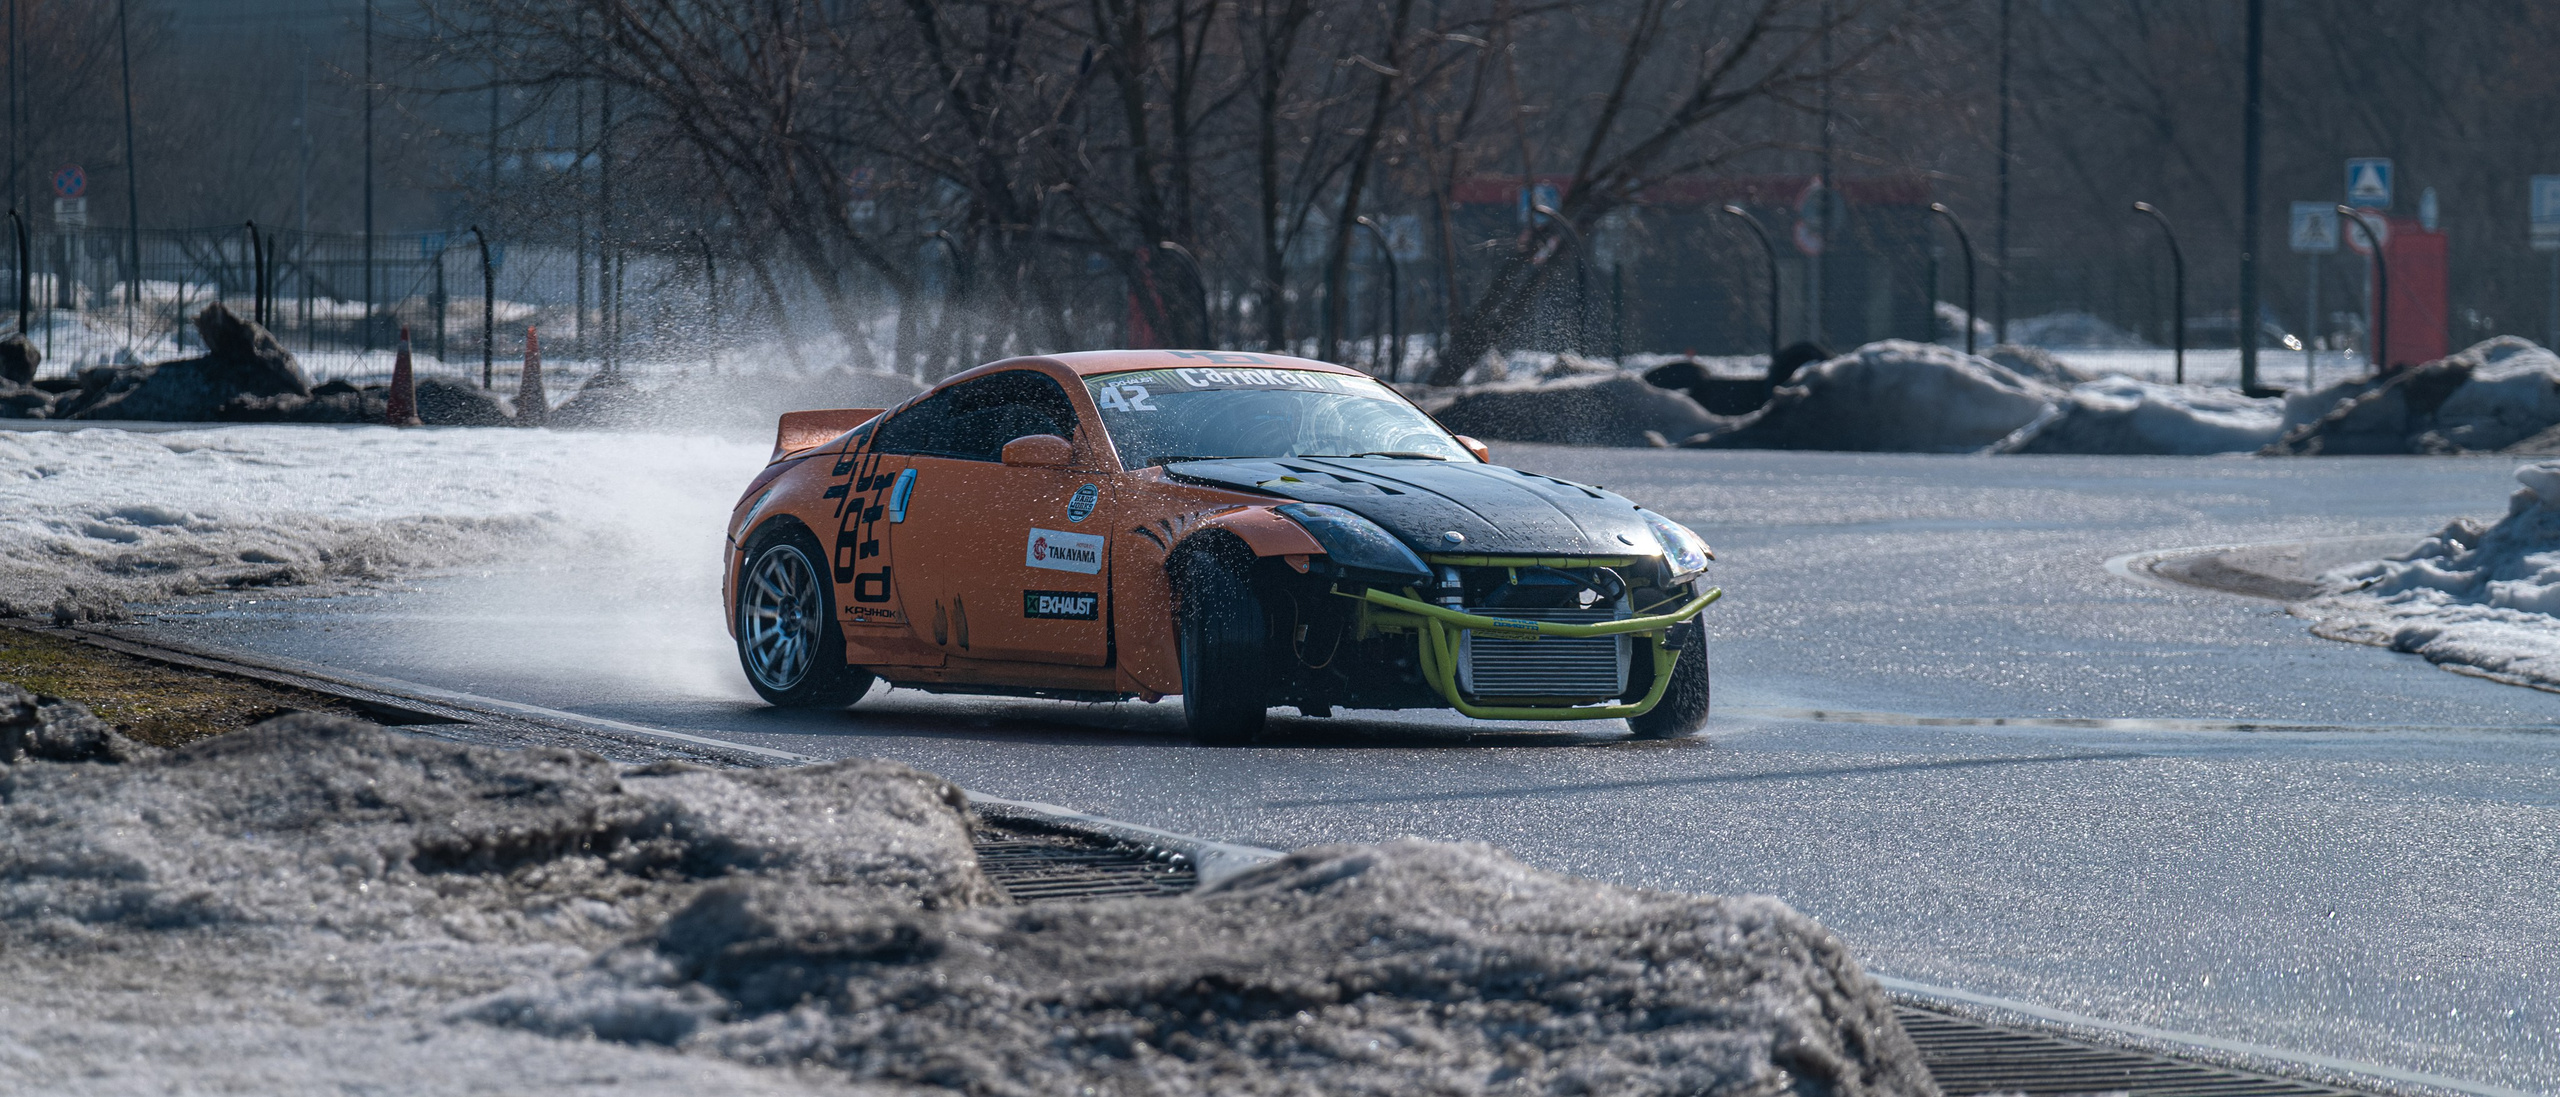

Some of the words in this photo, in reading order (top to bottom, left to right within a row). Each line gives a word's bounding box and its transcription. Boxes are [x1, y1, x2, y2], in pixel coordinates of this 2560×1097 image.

[1100, 386, 1158, 412] 42
[1070, 501, 1094, 510] WORKS
[1074, 494, 1096, 503] HARD
[1049, 546, 1095, 563] TAKAYAMA
[1039, 595, 1094, 614] EXHAUST
